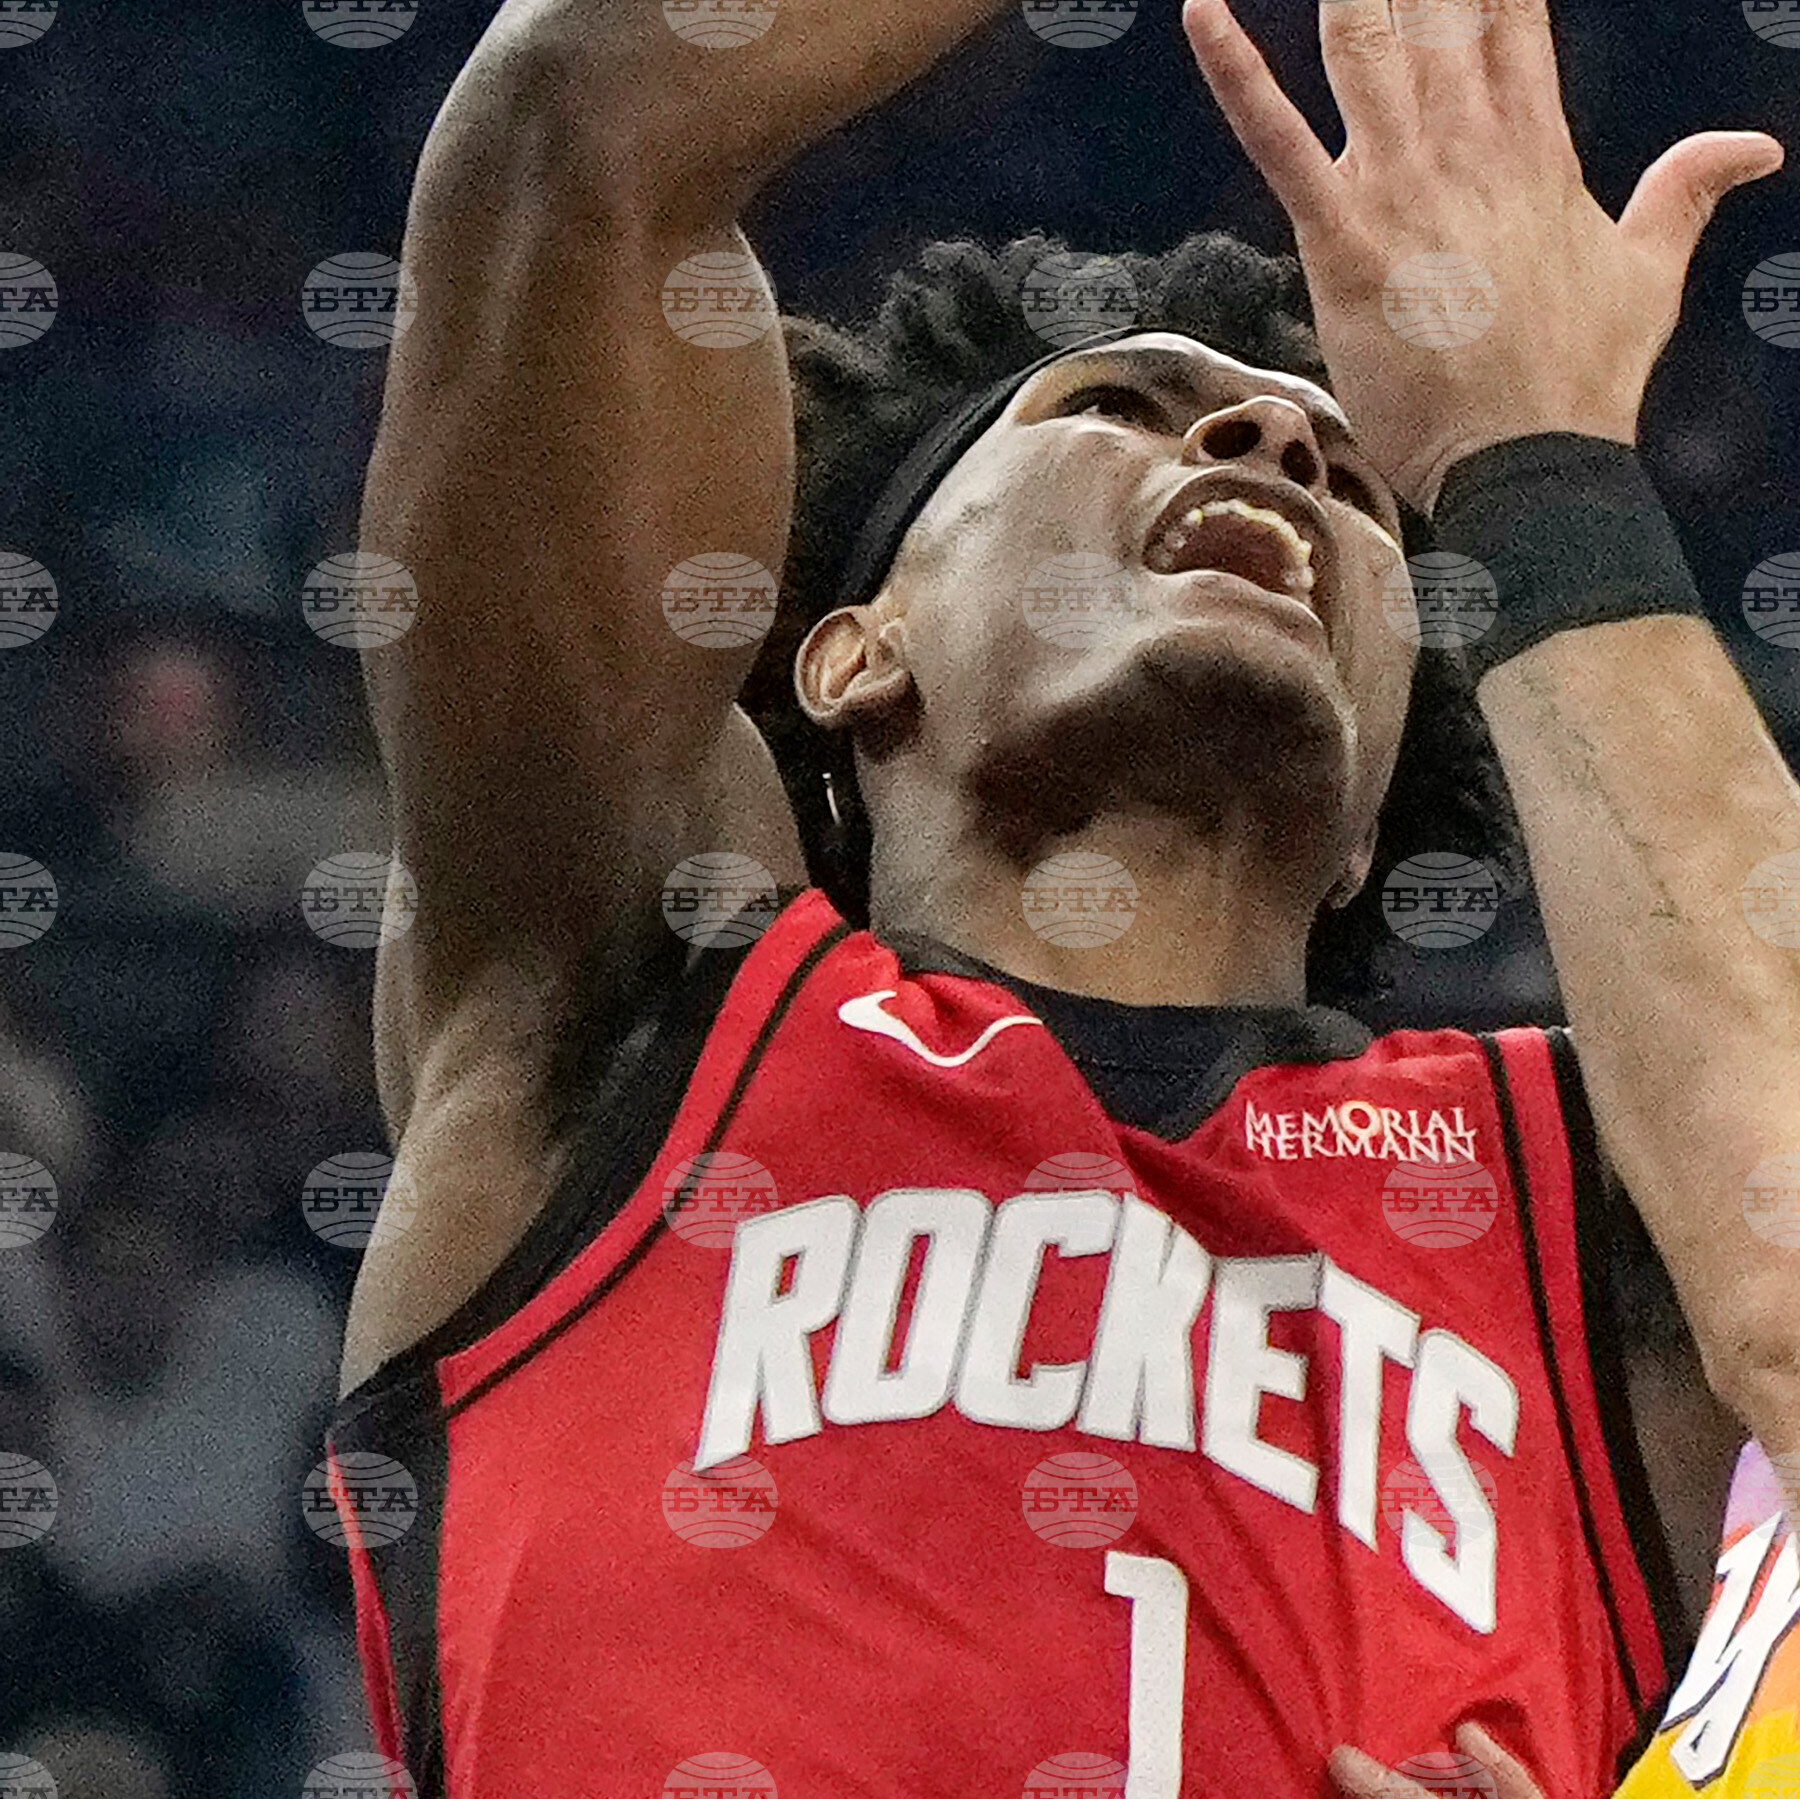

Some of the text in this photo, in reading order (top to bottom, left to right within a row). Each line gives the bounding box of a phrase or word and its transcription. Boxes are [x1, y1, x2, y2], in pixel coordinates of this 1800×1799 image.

[1246, 1100, 1478, 1140] MEMORIAL
[1247, 1129, 1476, 1162] HERMANN
[694, 1187, 1519, 1634] ROCKETS
